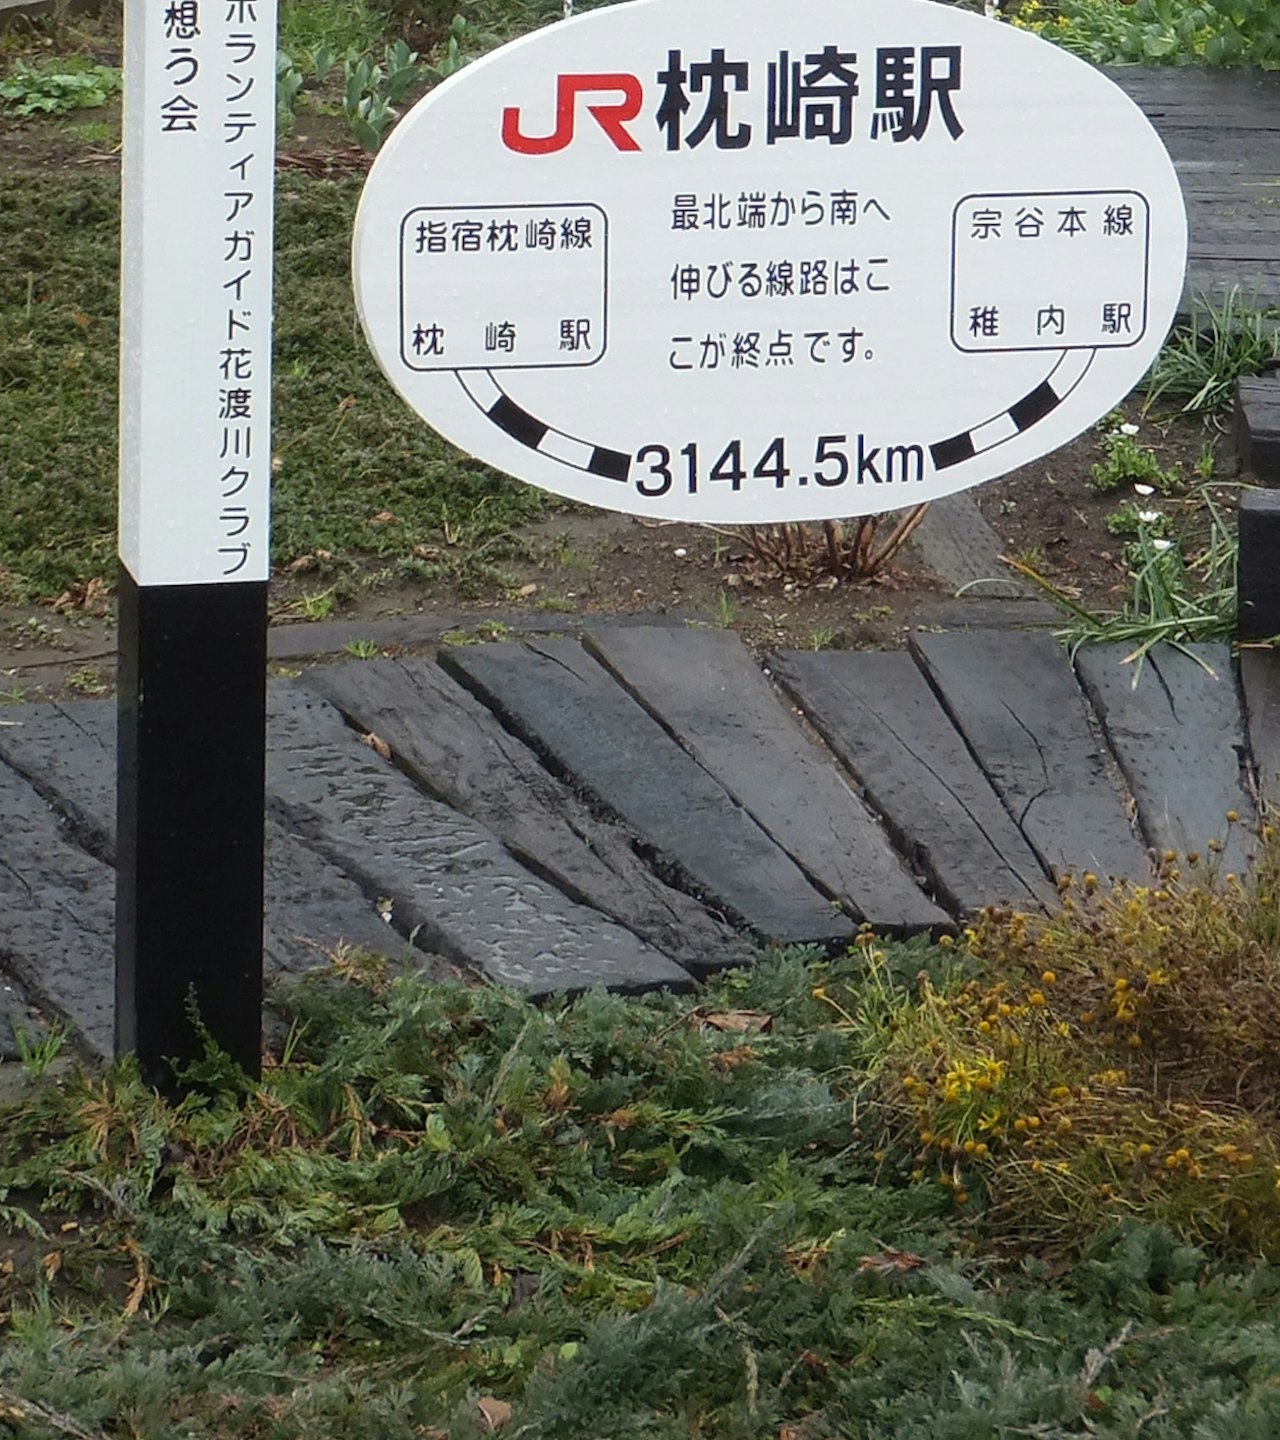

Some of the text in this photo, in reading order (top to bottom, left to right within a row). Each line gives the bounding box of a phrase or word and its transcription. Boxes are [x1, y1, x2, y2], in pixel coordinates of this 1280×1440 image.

[502, 45, 965, 155] JR 枕崎駅
[671, 189, 891, 231] 最北端から南へ
[970, 204, 1134, 240] 宗谷本線
[414, 216, 593, 254] 指宿枕崎線
[670, 258, 891, 301] 伸びる線路はこ
[412, 318, 592, 356] 枕崎駅
[969, 303, 1132, 338] 稚内駅
[669, 326, 874, 370] こが終点です。
[635, 433, 925, 497] 3144.5km
